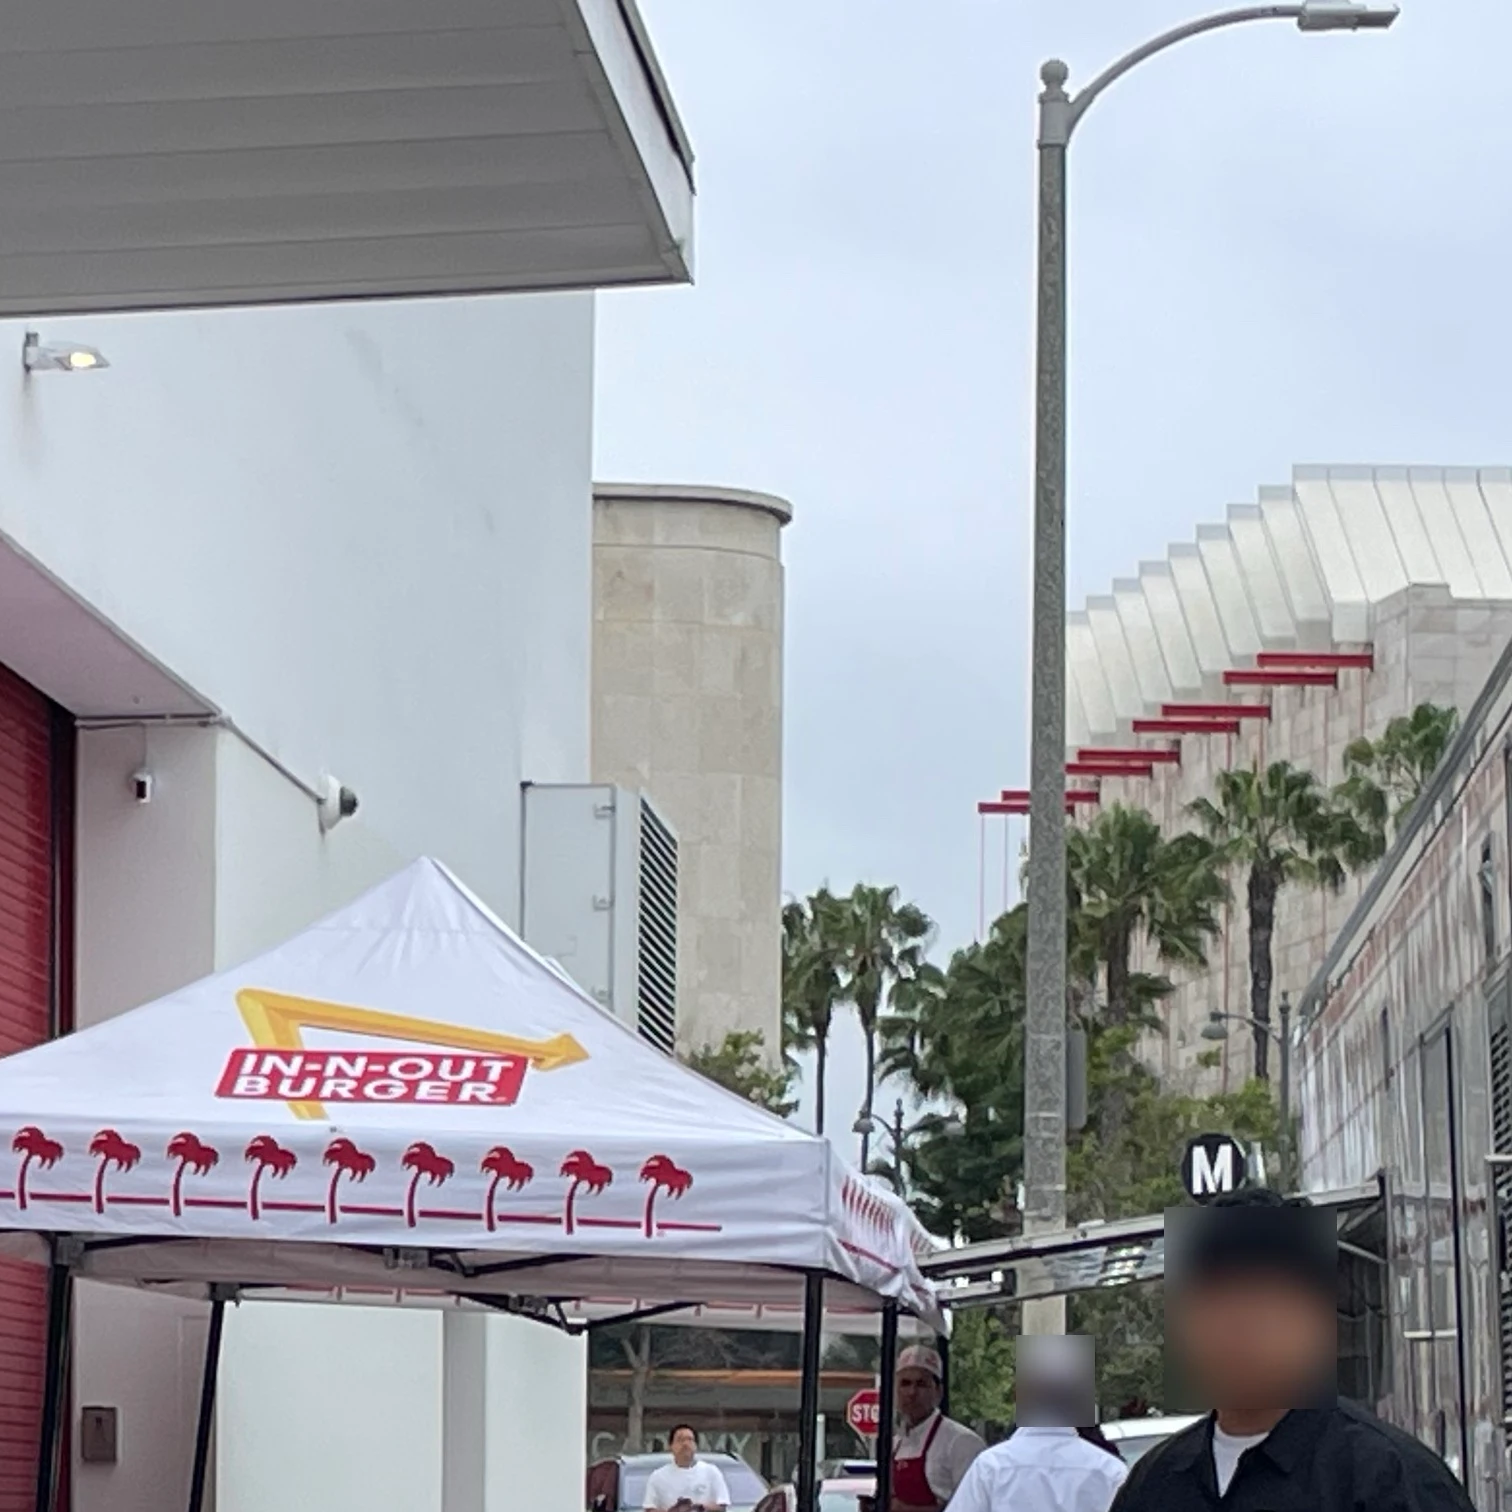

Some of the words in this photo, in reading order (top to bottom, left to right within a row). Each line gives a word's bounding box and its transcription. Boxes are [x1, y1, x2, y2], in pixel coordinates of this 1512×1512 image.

[239, 1053, 514, 1083] IN-N-OUT
[232, 1075, 501, 1102] BURGER
[1191, 1143, 1234, 1196] M
[851, 1403, 880, 1424] STO
